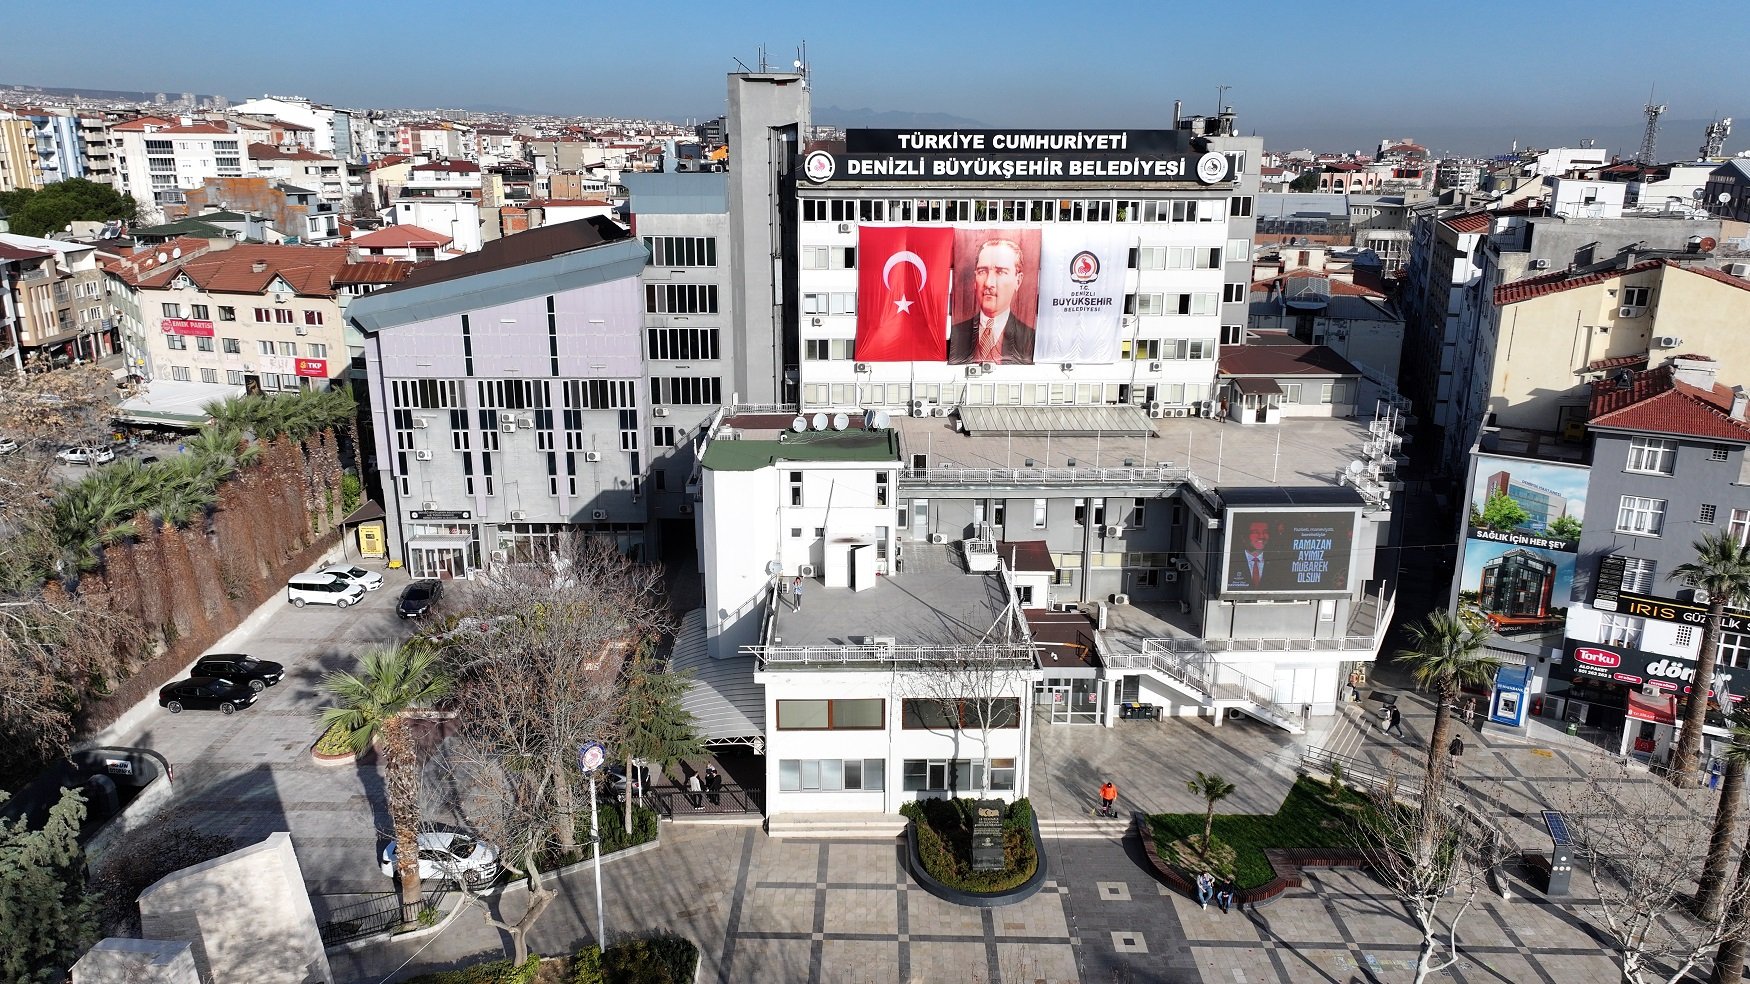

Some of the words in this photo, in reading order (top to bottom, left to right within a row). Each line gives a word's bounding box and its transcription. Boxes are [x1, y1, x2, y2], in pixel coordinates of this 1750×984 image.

[898, 130, 984, 149] TÜRKİYE
[993, 130, 1127, 150] CUMHURİYETİ
[847, 157, 925, 175] DENİZLİ
[933, 157, 1063, 178] BÜYÜKŞEHİR
[1069, 158, 1186, 176] BELEDİYESİ
[1293, 539, 1332, 550] RAMAZAN
[1476, 530, 1509, 542] SAĞLIK
[1509, 534, 1529, 545] İÇİN
[1529, 537, 1548, 547] HER
[1548, 541, 1567, 550] ŞEY
[1298, 550, 1325, 561] AYIMIZ
[1297, 572, 1321, 583] OLSUN
[1683, 612, 1741, 629] GÜZLİK
[1580, 649, 1615, 665] Torku
[1646, 659, 1733, 684] dönr
